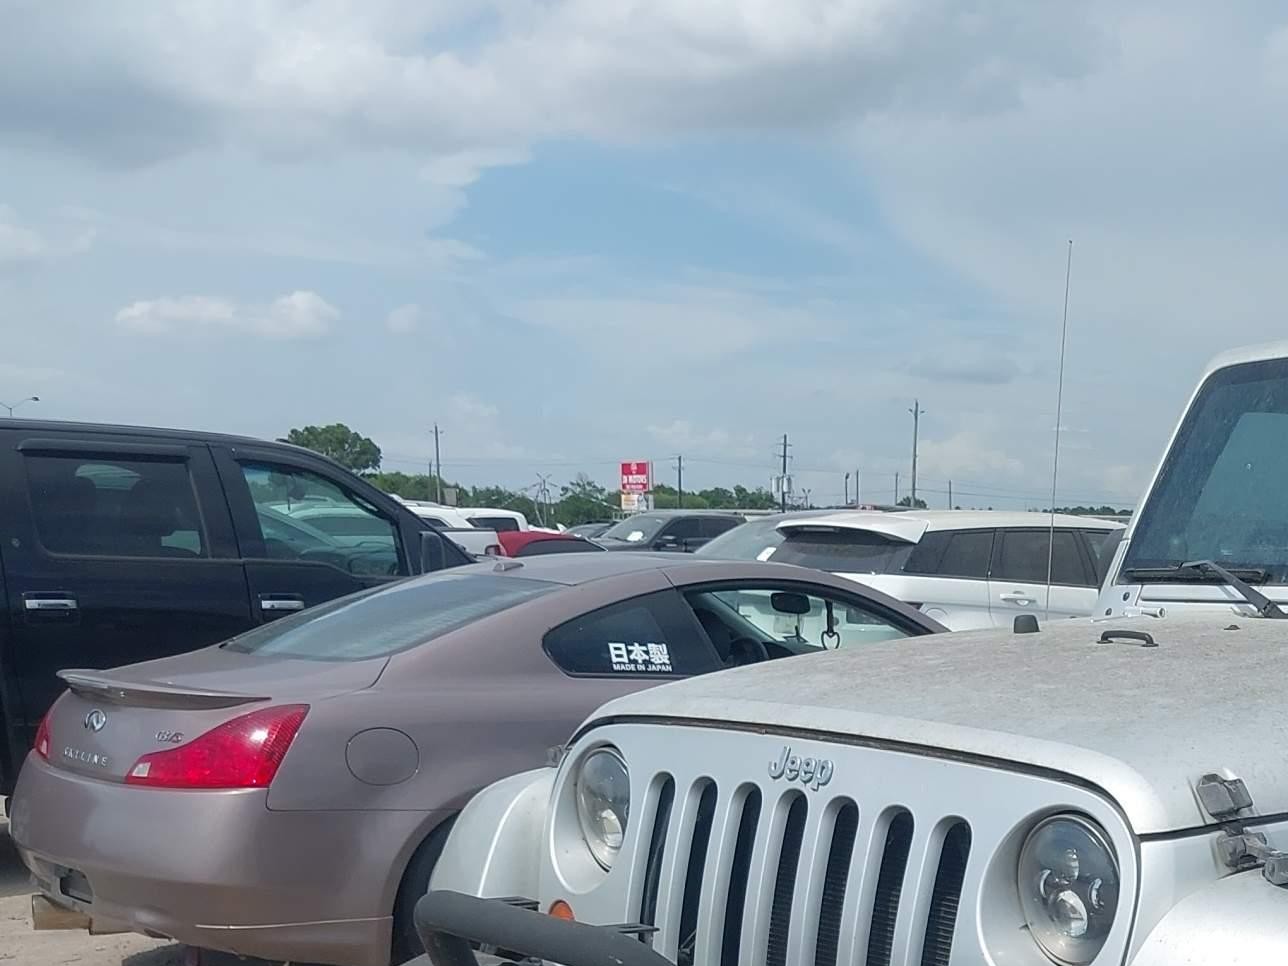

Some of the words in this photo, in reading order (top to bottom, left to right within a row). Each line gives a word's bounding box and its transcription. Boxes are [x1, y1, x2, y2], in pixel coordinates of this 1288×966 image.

[607, 642, 670, 664] 日本製
[612, 663, 636, 672] MADE
[768, 745, 833, 792] Jeep
